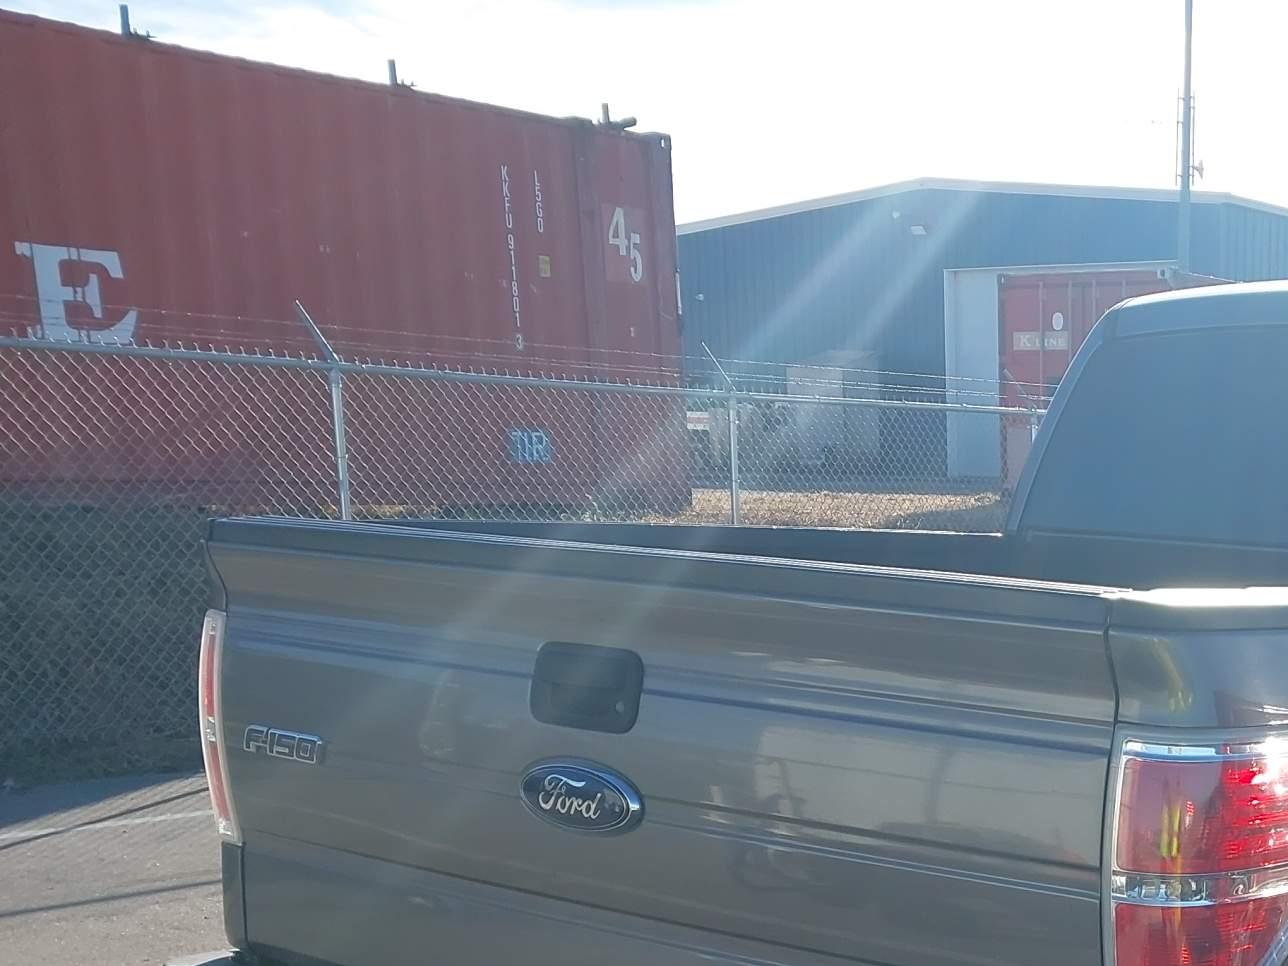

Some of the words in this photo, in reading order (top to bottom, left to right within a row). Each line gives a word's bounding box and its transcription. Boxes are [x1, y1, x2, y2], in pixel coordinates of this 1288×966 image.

[608, 206, 643, 283] 45
[14, 240, 138, 344] E
[538, 773, 602, 819] Ford
